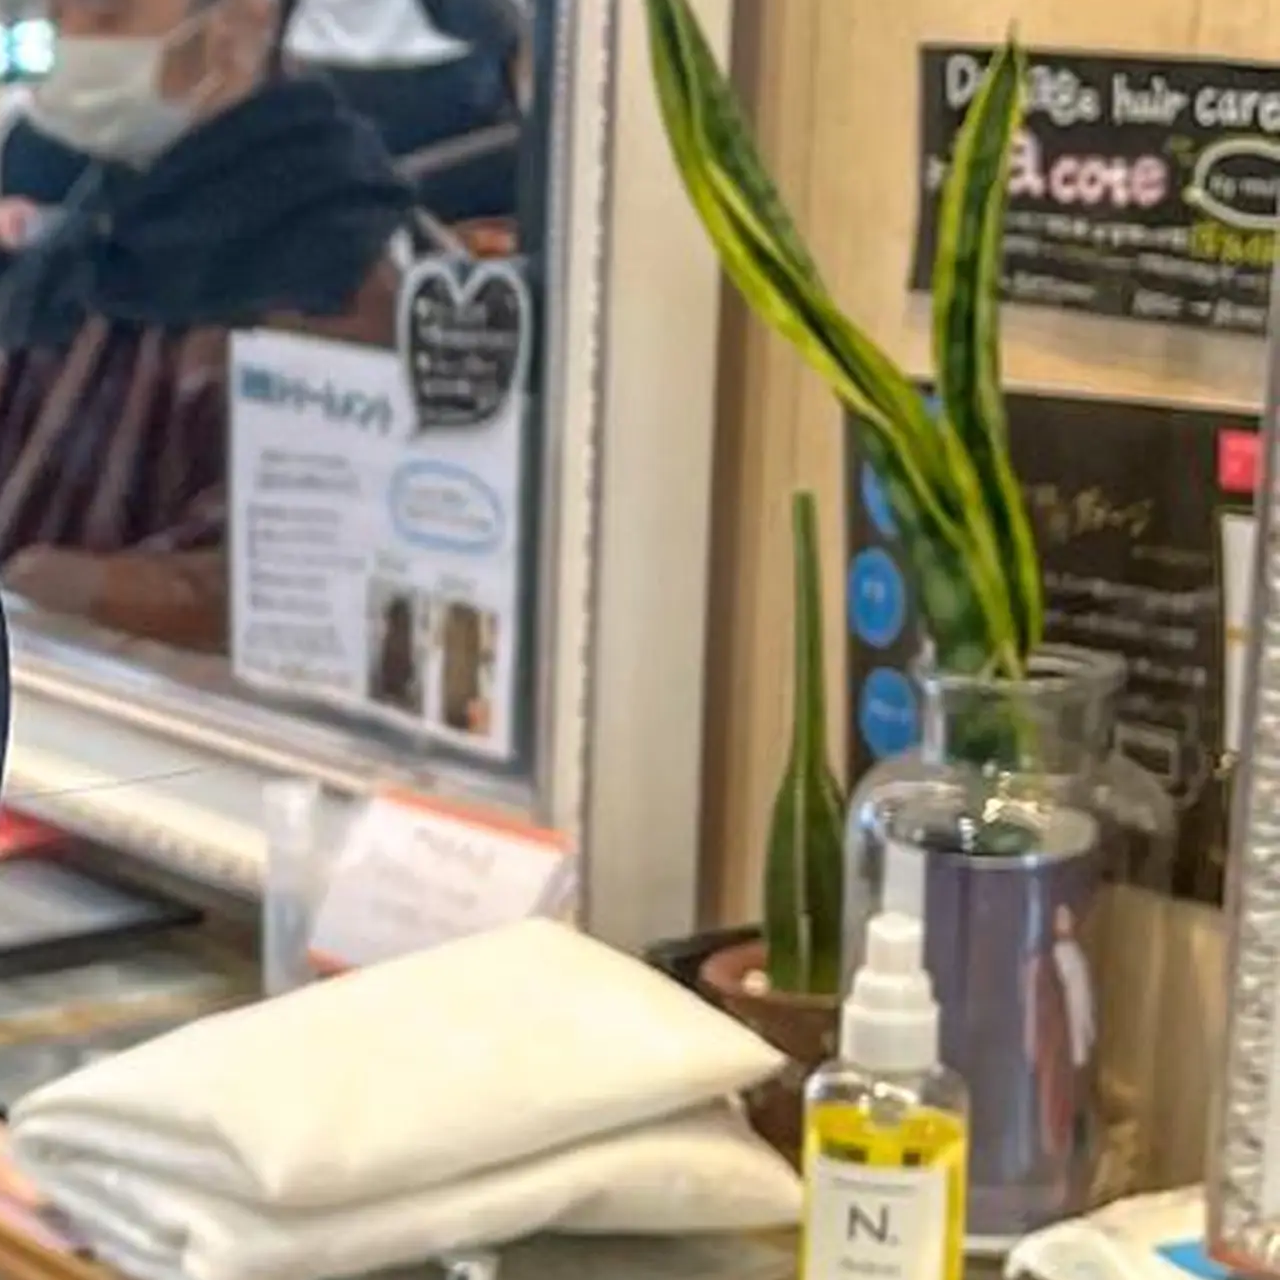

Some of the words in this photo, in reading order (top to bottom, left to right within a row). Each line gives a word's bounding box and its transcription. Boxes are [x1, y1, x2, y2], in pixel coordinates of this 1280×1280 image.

[1113, 72, 1190, 127] hair
[1194, 85, 1280, 134] care
[846, 1202, 901, 1248] N.
